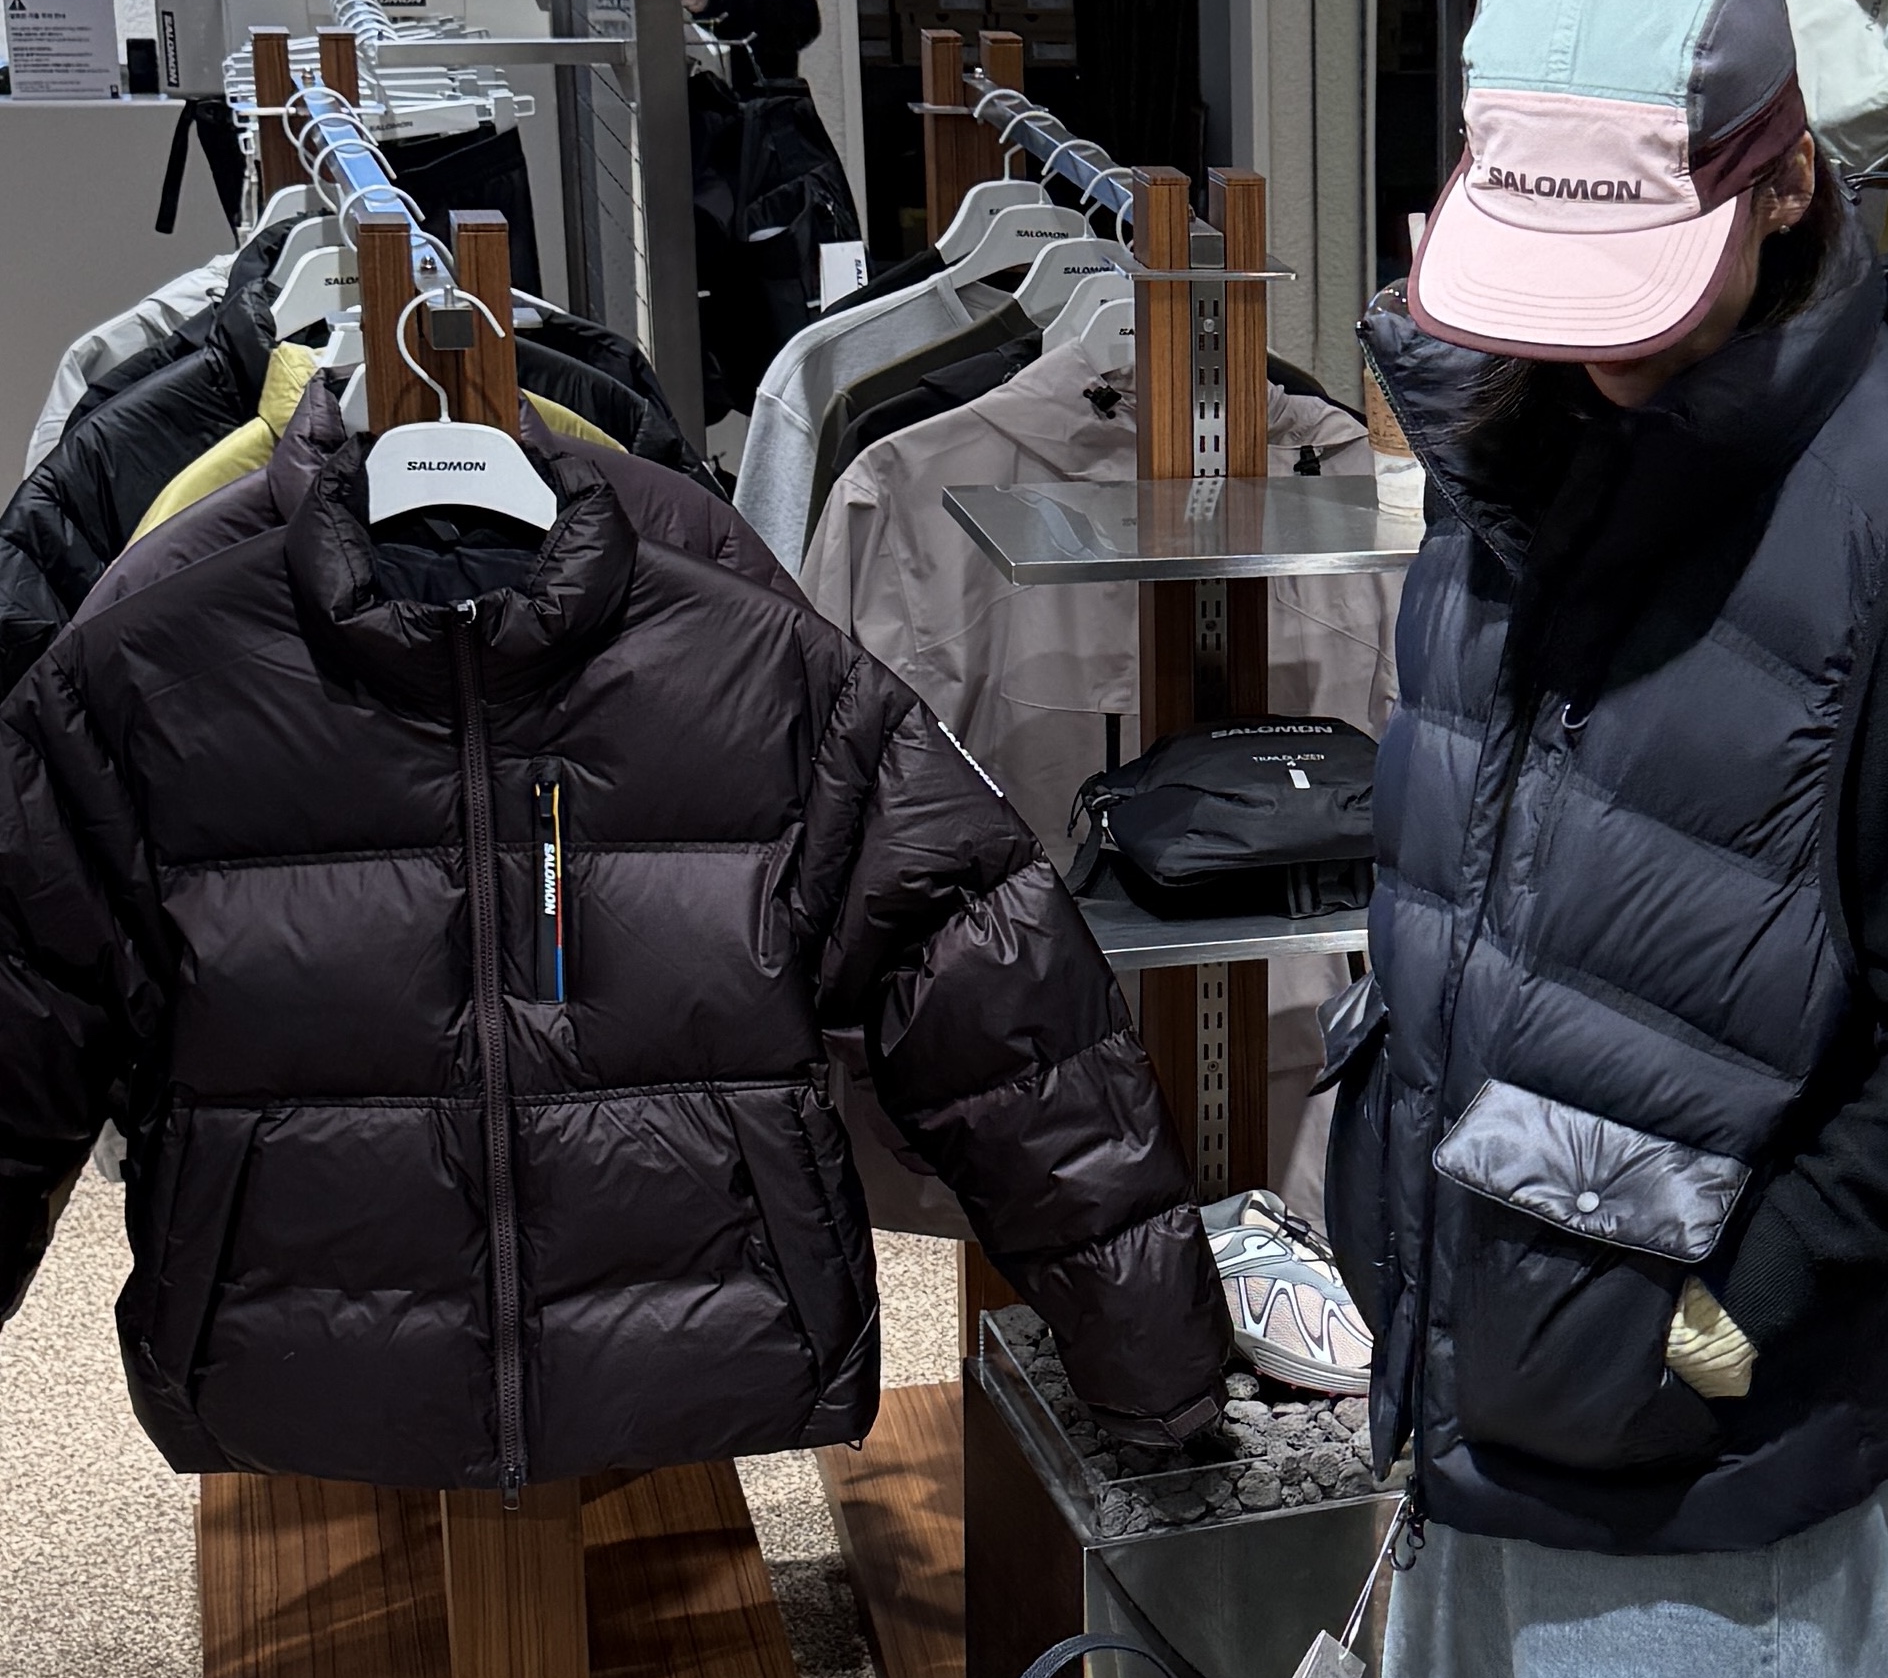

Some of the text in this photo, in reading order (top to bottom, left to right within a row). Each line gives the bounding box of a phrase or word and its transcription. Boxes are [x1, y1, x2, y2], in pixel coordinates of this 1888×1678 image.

[163, 14, 178, 85] SALOMON
[1488, 166, 1642, 202] SALOMON
[1015, 230, 1069, 239] SALOMON
[406, 461, 486, 472] SALOMON
[1211, 725, 1333, 739] SALOMON
[543, 842, 556, 916] SALOMON
